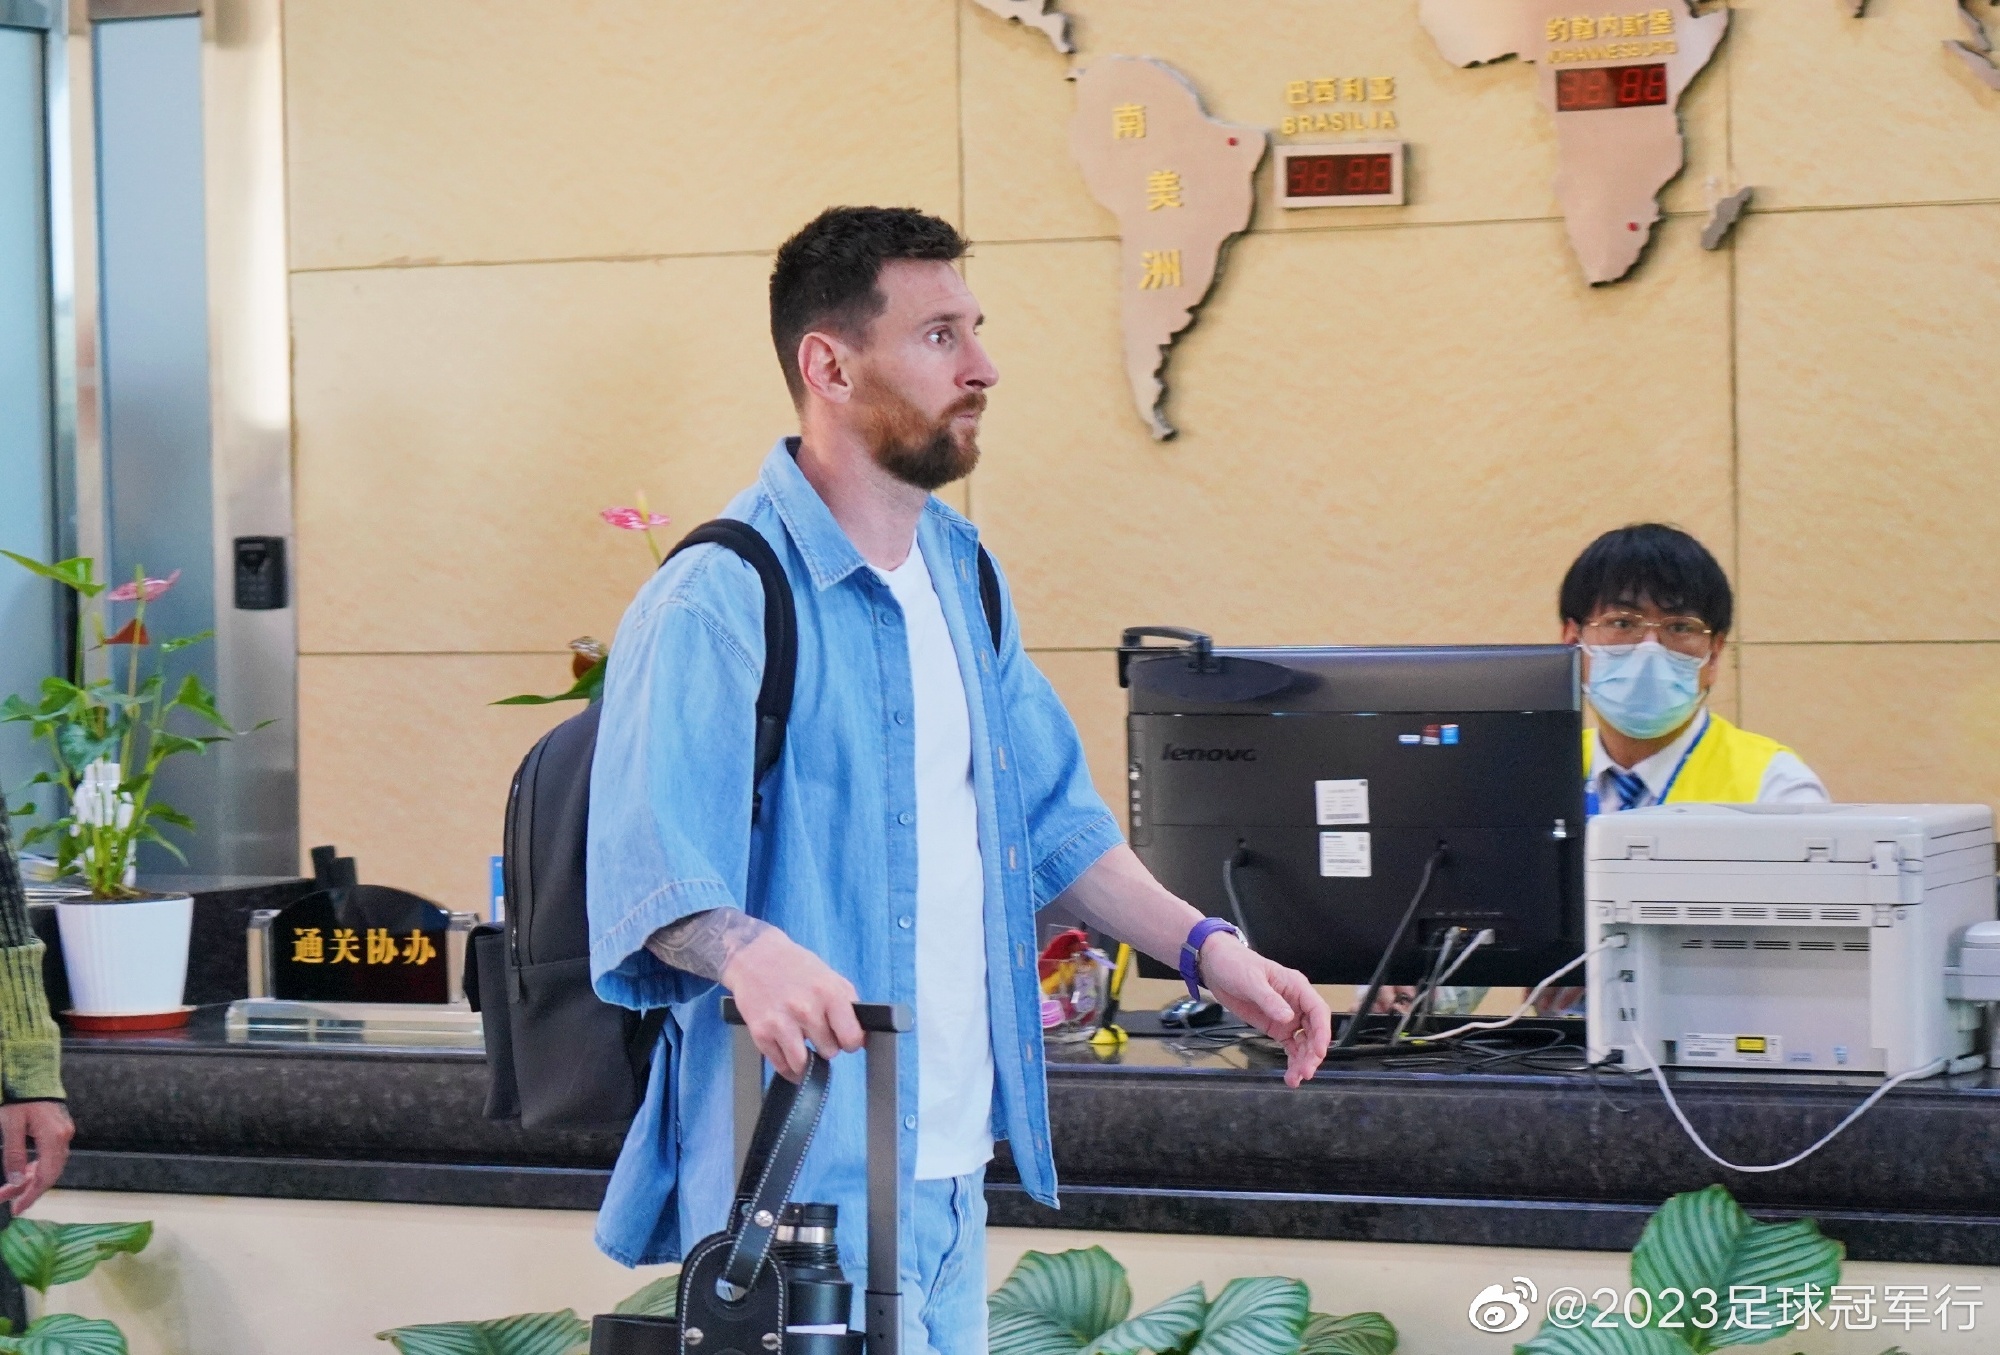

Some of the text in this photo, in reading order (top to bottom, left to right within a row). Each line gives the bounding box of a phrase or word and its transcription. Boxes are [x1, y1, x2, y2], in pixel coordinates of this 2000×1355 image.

[1287, 77, 1393, 104] 巴西利亚
[1282, 111, 1395, 136] BRASILIA
[1112, 102, 1183, 290] 南美洲
[291, 927, 436, 965] 通关协办
